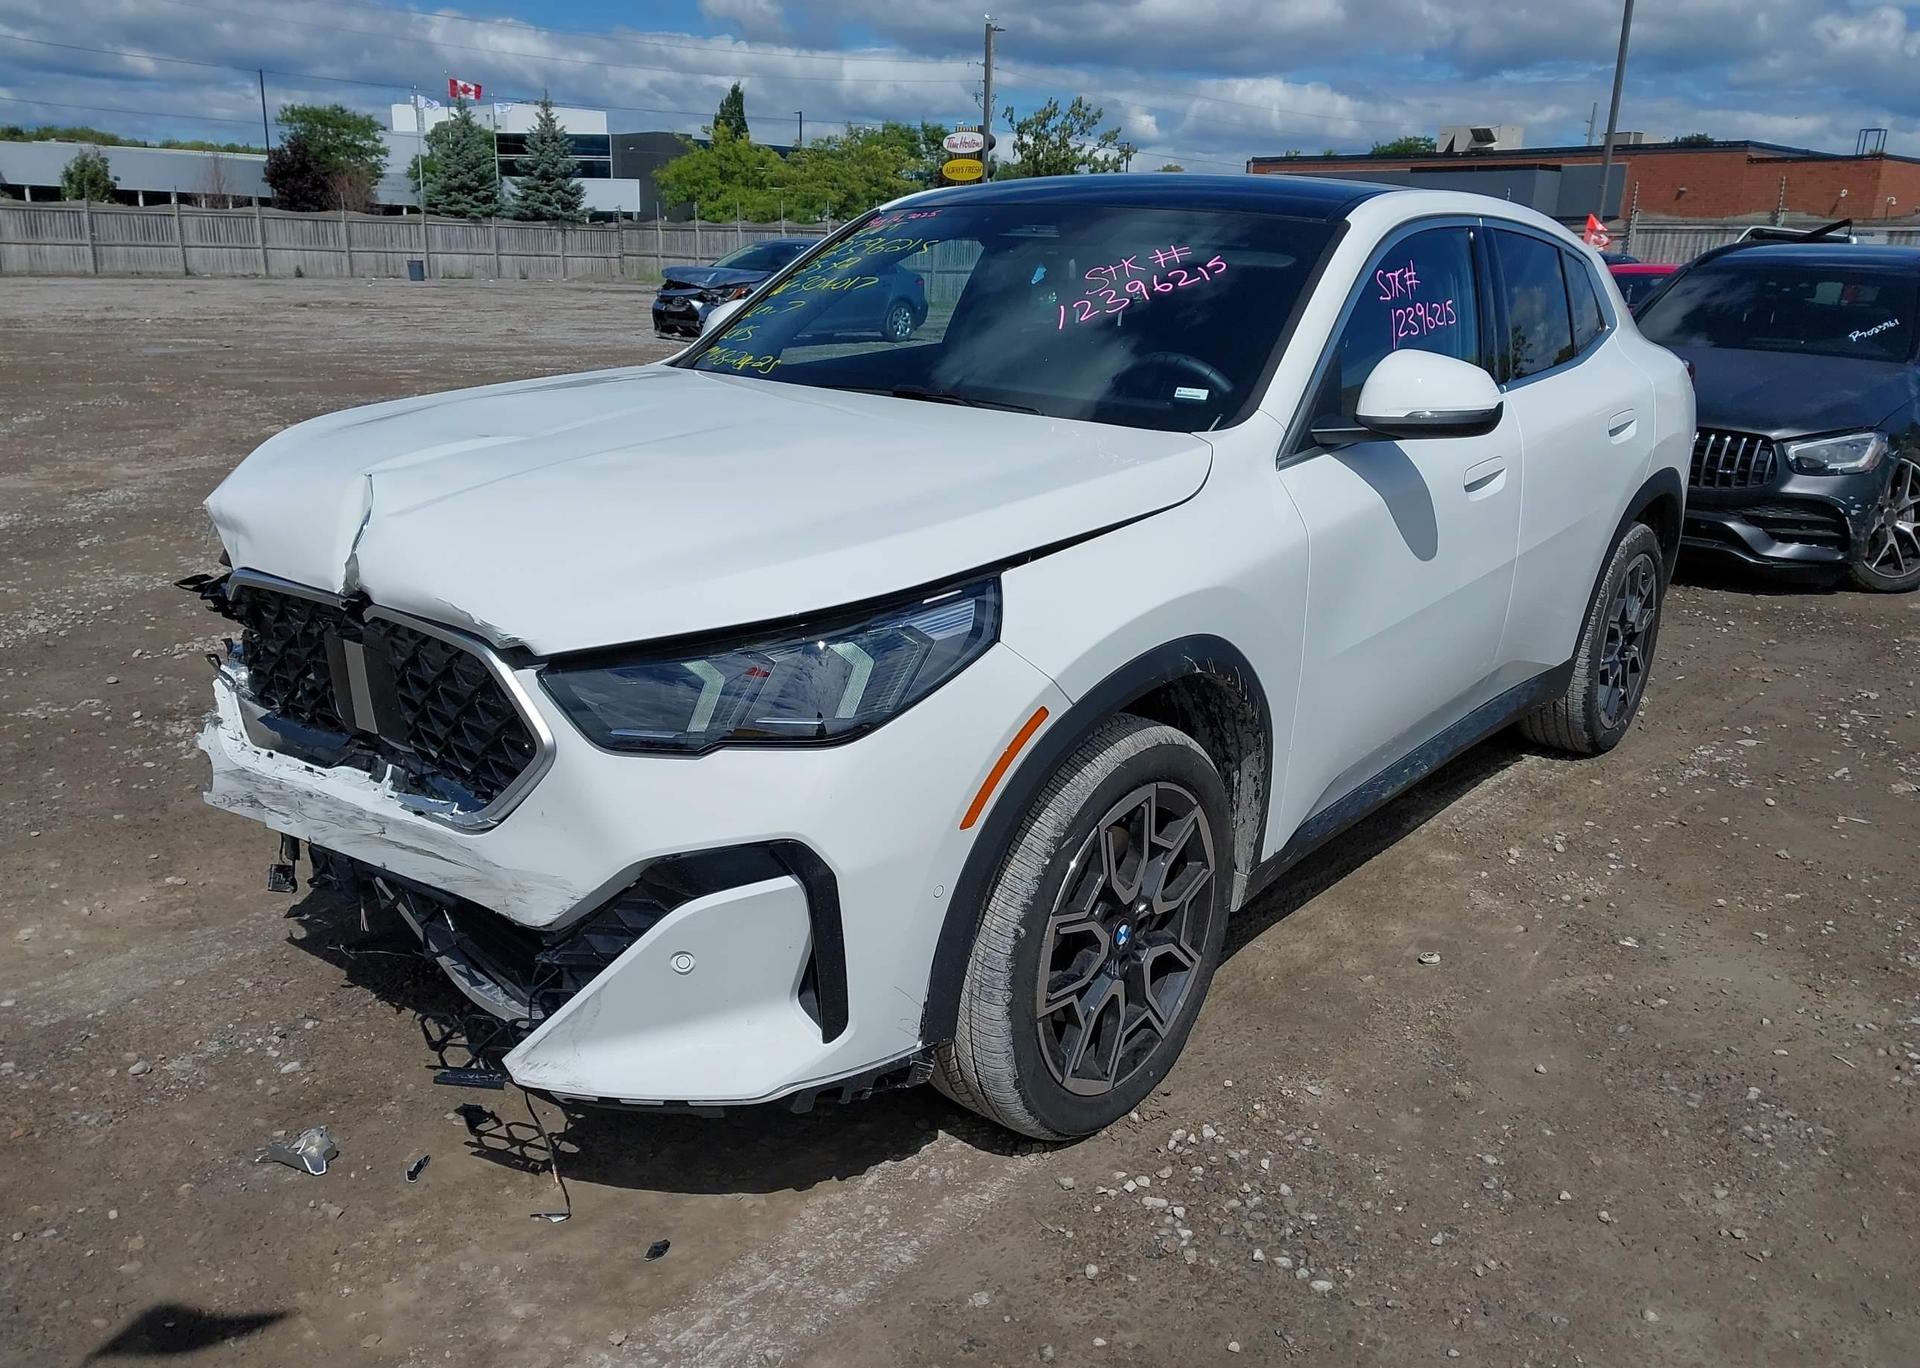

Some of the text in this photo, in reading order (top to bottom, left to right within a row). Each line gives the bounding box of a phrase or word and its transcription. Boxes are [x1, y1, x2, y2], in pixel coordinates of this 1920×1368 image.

[947, 136, 959, 149] Tim
[1058, 255, 1226, 330] 12396215
[1391, 299, 1457, 350] 12396215
